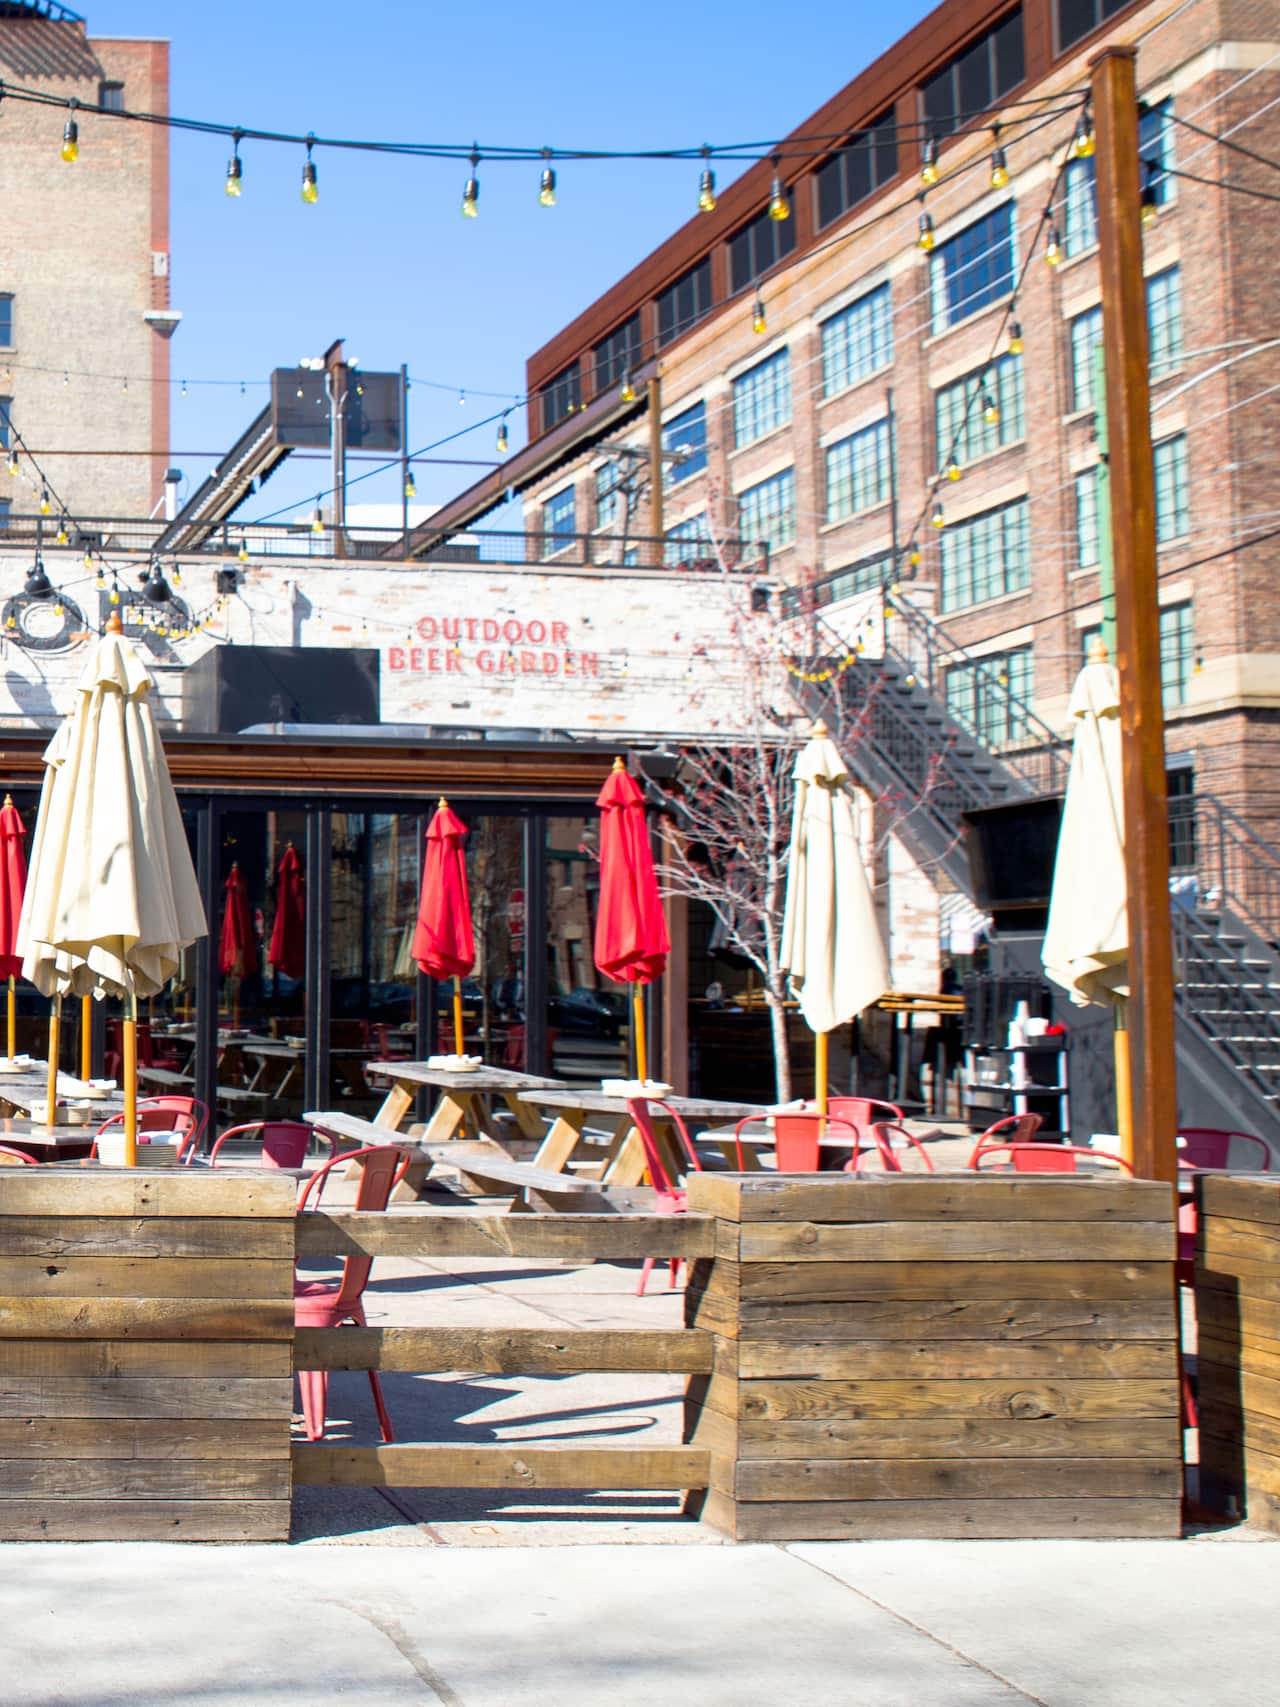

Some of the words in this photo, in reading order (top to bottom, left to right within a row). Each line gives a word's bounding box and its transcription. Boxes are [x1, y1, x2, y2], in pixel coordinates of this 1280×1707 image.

[417, 616, 569, 645] OUTDOOR
[388, 647, 463, 673] BEER
[475, 650, 600, 677] GARDEN
